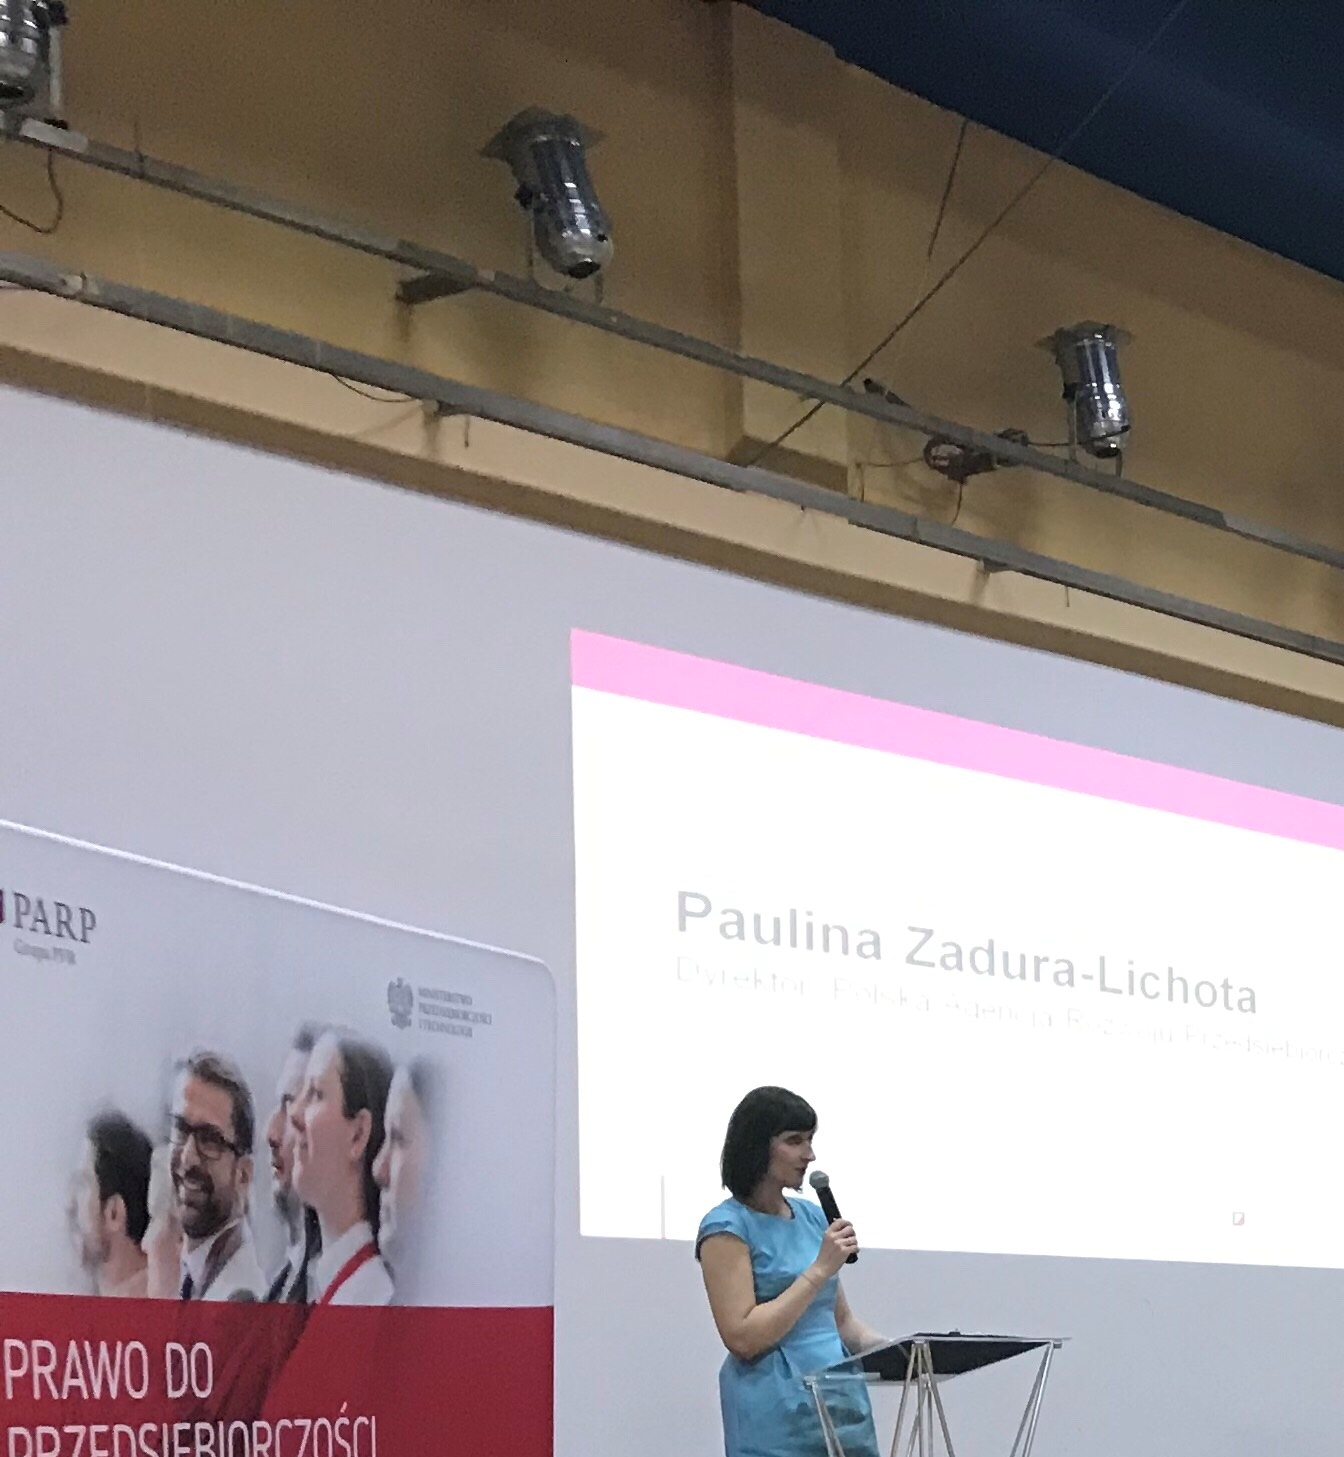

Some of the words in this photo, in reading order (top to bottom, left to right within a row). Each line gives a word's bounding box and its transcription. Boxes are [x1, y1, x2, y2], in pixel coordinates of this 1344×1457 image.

[13, 891, 97, 944] PARP
[677, 890, 882, 961] Paulina
[905, 925, 1257, 1014] Zadura-Lichota
[3, 1338, 149, 1400] PRAWO
[165, 1341, 214, 1399] DO
